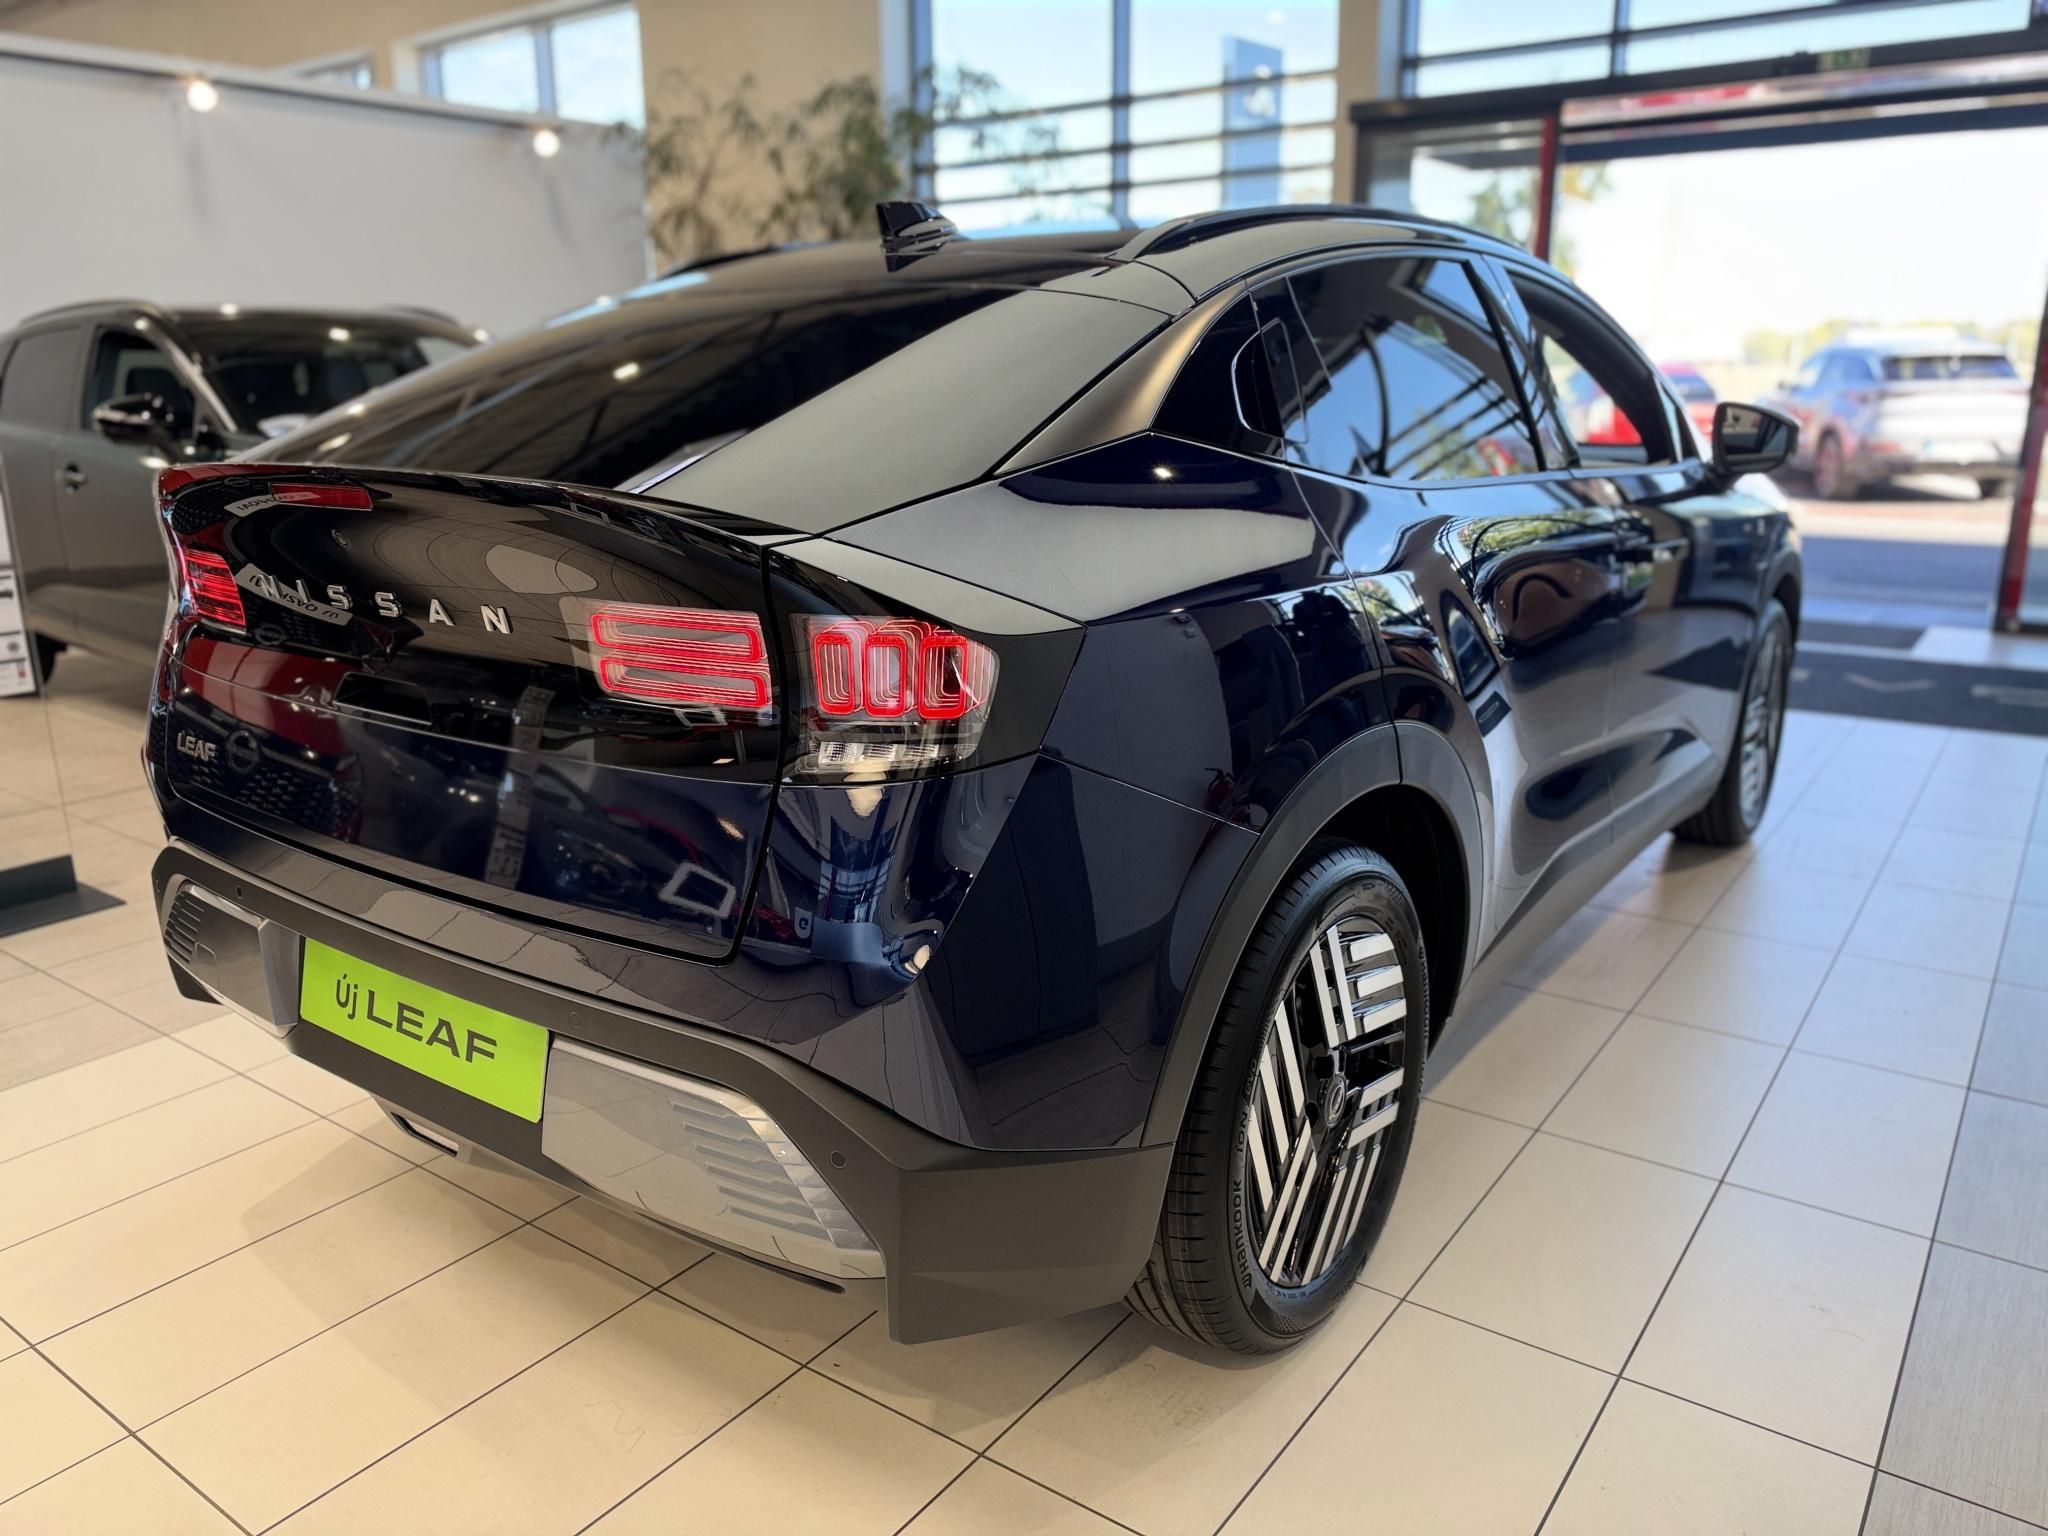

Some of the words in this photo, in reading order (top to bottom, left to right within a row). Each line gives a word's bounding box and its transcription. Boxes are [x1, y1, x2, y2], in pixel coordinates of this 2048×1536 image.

[258, 573, 513, 635] NISSAN
[176, 732, 217, 762] LEAF
[335, 973, 359, 1020] Új
[366, 989, 498, 1064] LEAF
